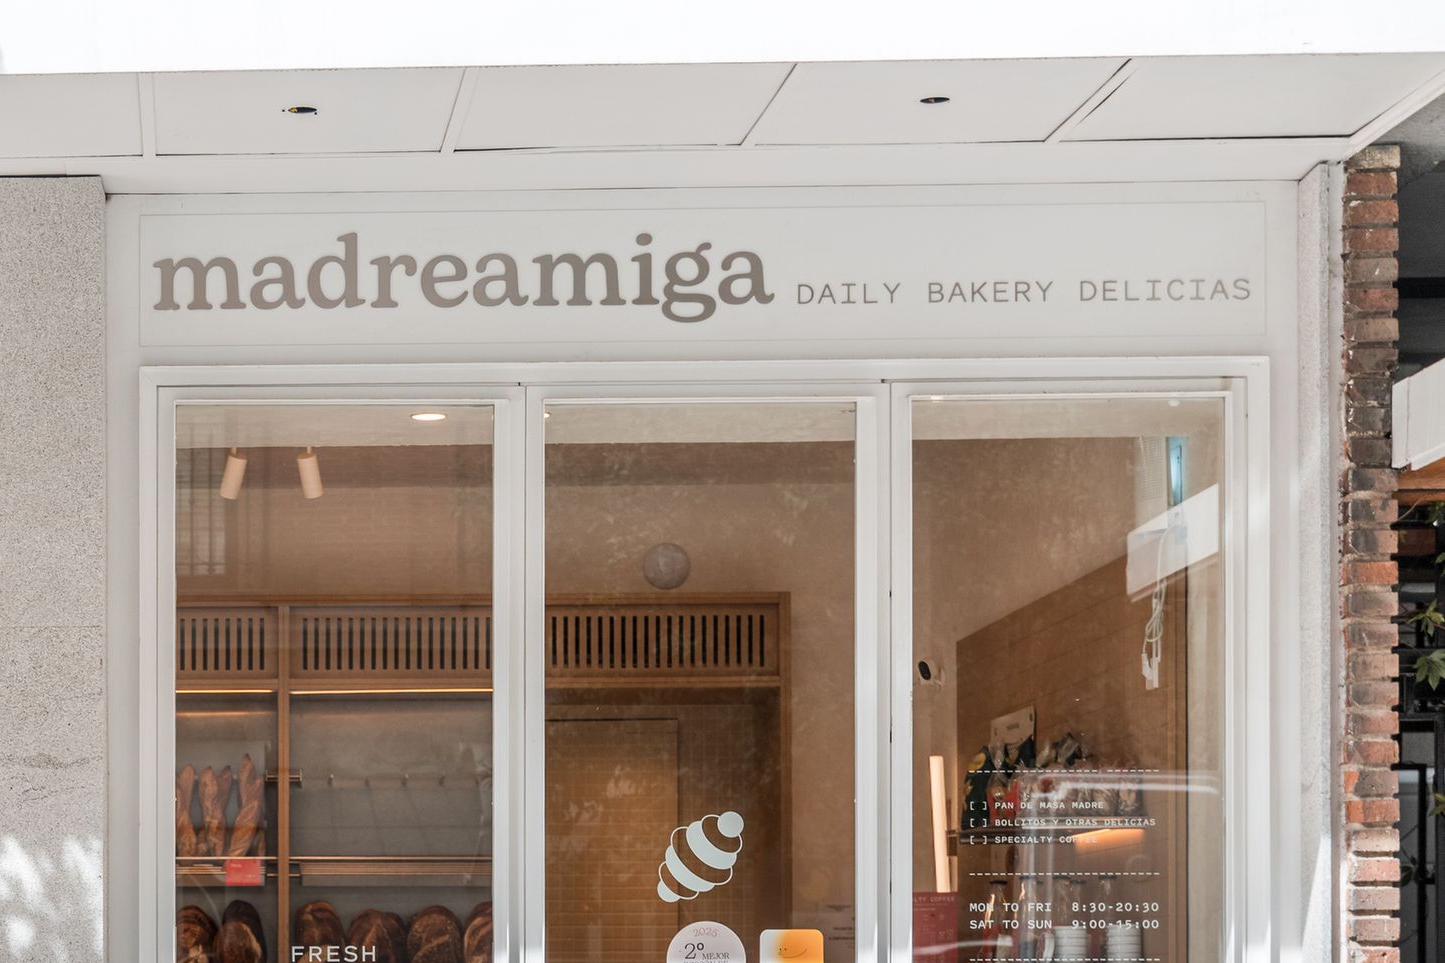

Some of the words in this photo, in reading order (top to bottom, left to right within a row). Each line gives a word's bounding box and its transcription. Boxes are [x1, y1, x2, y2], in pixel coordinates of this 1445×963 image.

[153, 232, 775, 323] madreamiga
[796, 282, 901, 304] DAILY
[928, 281, 1054, 303] BAKERY
[1079, 278, 1252, 301] DELICIAS
[994, 801, 1014, 809] PAN
[1020, 801, 1033, 809] DE
[1039, 801, 1065, 809] MASA
[1071, 801, 1104, 809] MADRE
[994, 818, 1046, 827] BOLLITOS
[1053, 818, 1059, 826] Y
[1065, 818, 1098, 826] OTRAS
[1104, 818, 1156, 826] DELICIAS
[994, 836, 1052, 844] SPECIALTY
[969, 903, 994, 912] MON
[1004, 903, 1019, 912] TO
[1028, 903, 1052, 912] FRI
[1071, 902, 1160, 912] 8:30-20:30
[969, 920, 995, 929] SAT
[1004, 920, 1019, 929] TO
[1028, 920, 1052, 929] SUN
[1071, 920, 1160, 929] 9:00-15:00
[291, 945, 376, 962] FRESH
[702, 952, 730, 960] MEJOR
